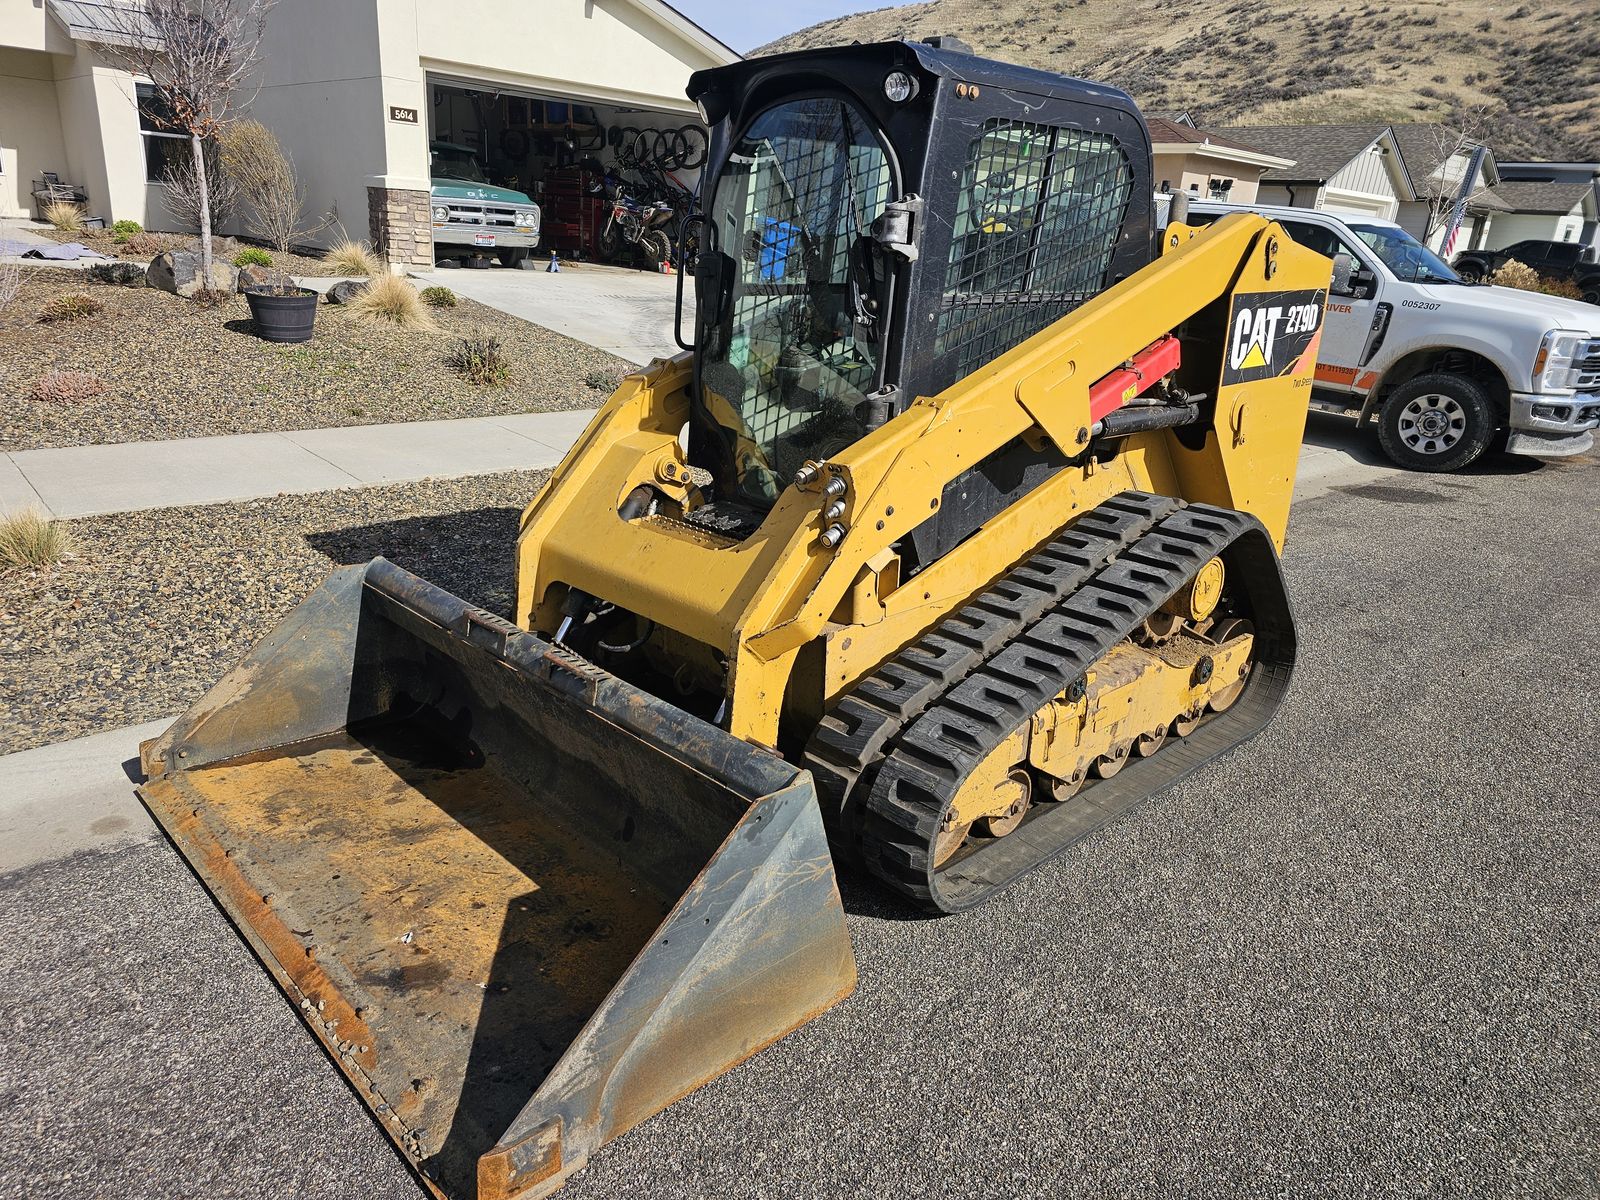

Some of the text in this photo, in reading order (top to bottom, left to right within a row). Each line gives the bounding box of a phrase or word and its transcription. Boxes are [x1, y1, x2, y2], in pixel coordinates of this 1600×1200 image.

[395, 109, 414, 121] 5614
[1401, 299, 1441, 311] 0052307
[1231, 306, 1283, 370] CAT
[1285, 303, 1319, 334] 279D
